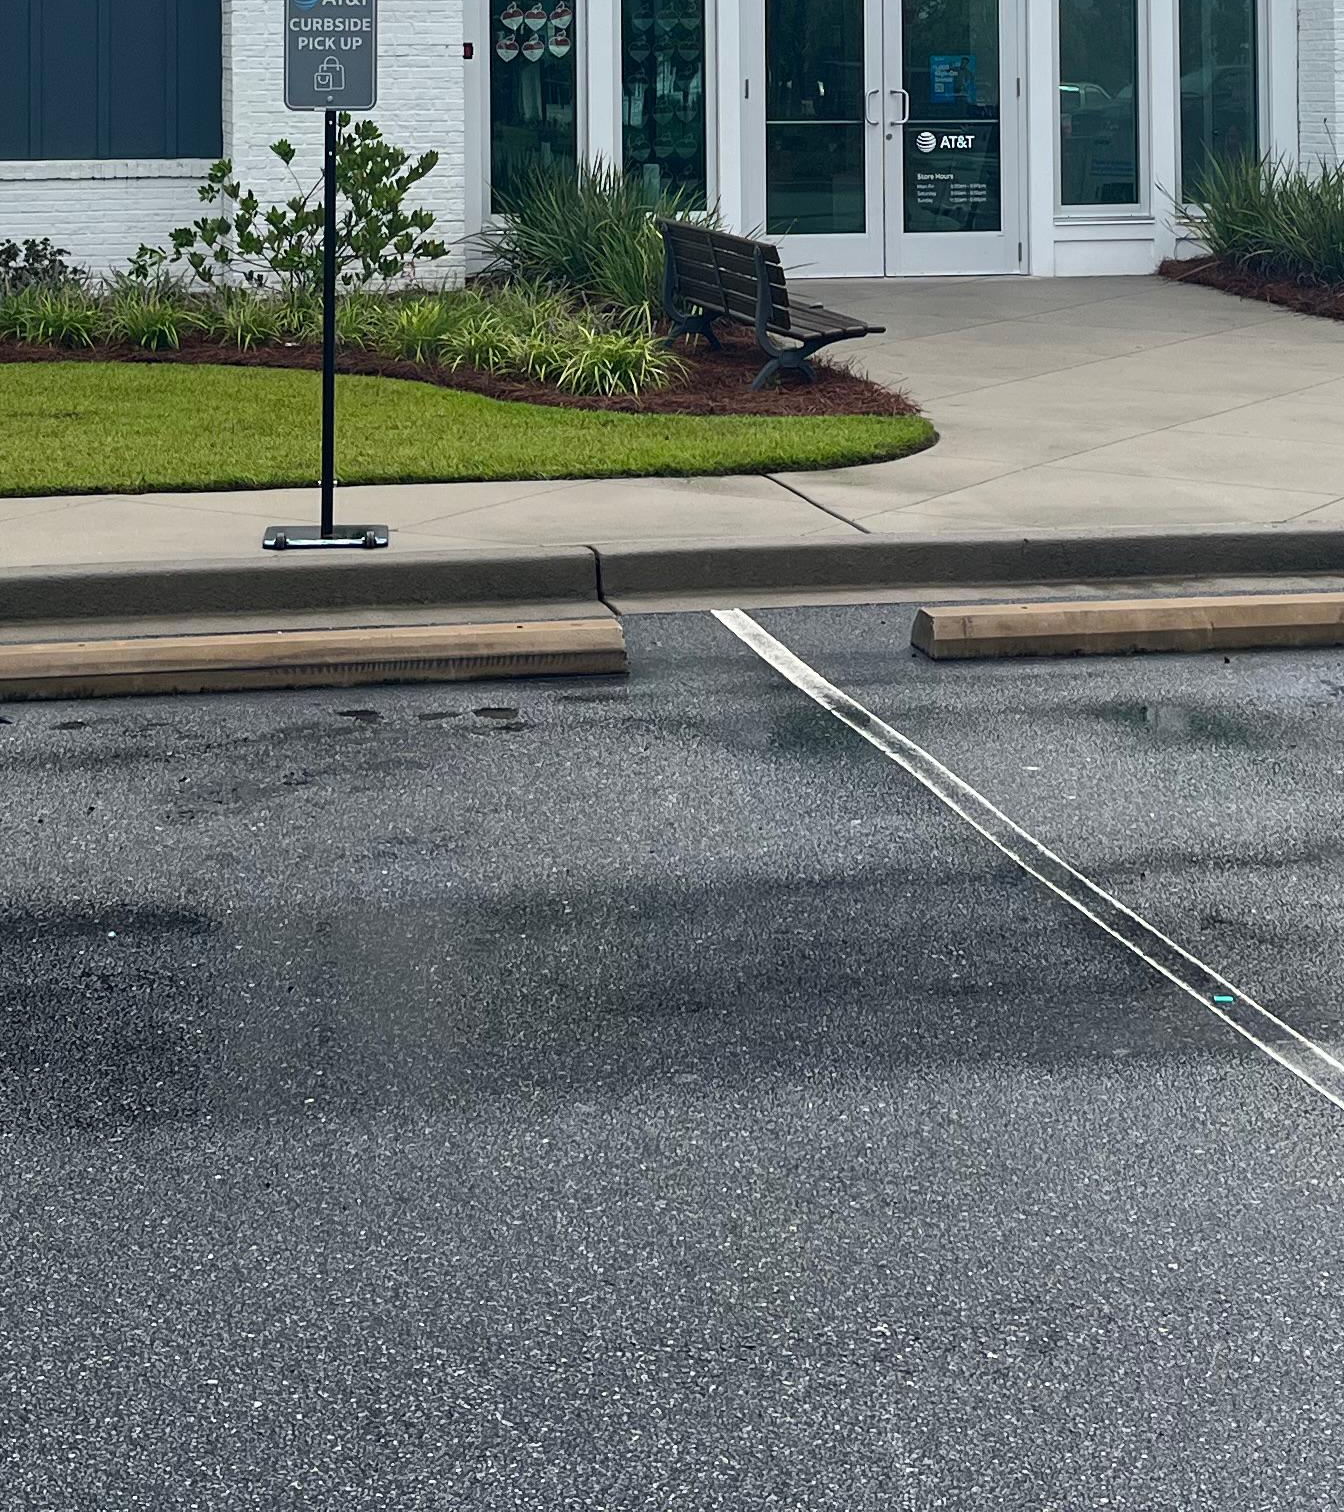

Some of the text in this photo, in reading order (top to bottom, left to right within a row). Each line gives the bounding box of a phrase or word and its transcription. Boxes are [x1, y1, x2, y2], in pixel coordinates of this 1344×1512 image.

[289, 17, 372, 32] CURBSIDE
[297, 36, 364, 51] PICK UP
[939, 134, 976, 149] AT&T
